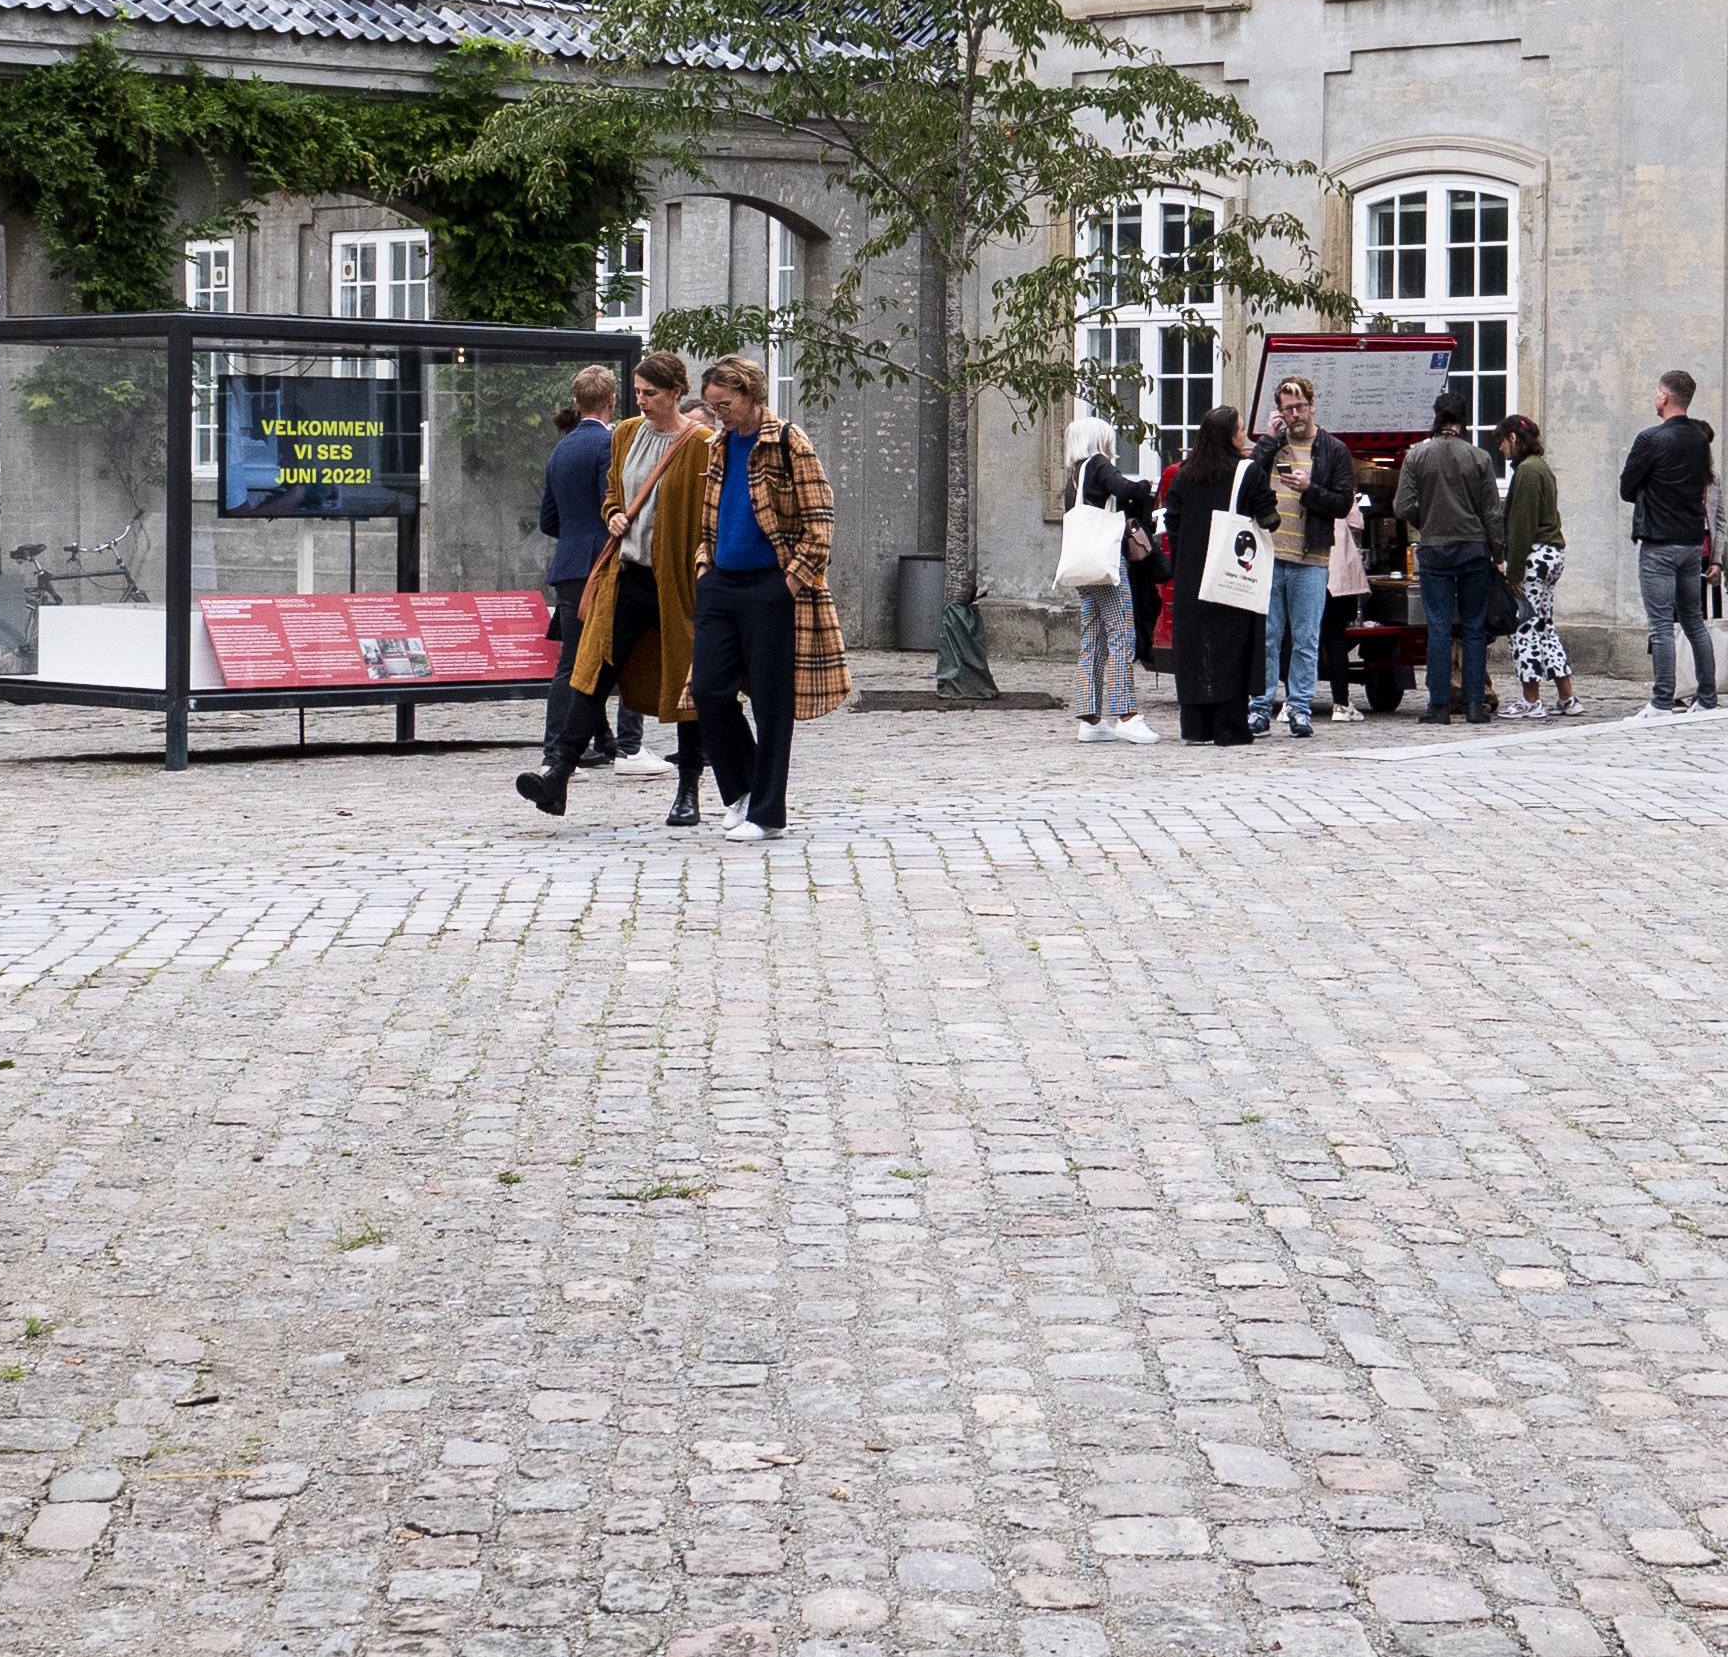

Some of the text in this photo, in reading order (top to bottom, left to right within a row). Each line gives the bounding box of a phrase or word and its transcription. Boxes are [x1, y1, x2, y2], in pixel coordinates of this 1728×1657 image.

[260, 419, 385, 437] VELKOMMEN!
[293, 444, 354, 461] VI SES
[275, 468, 372, 485] JUNI 2022!
